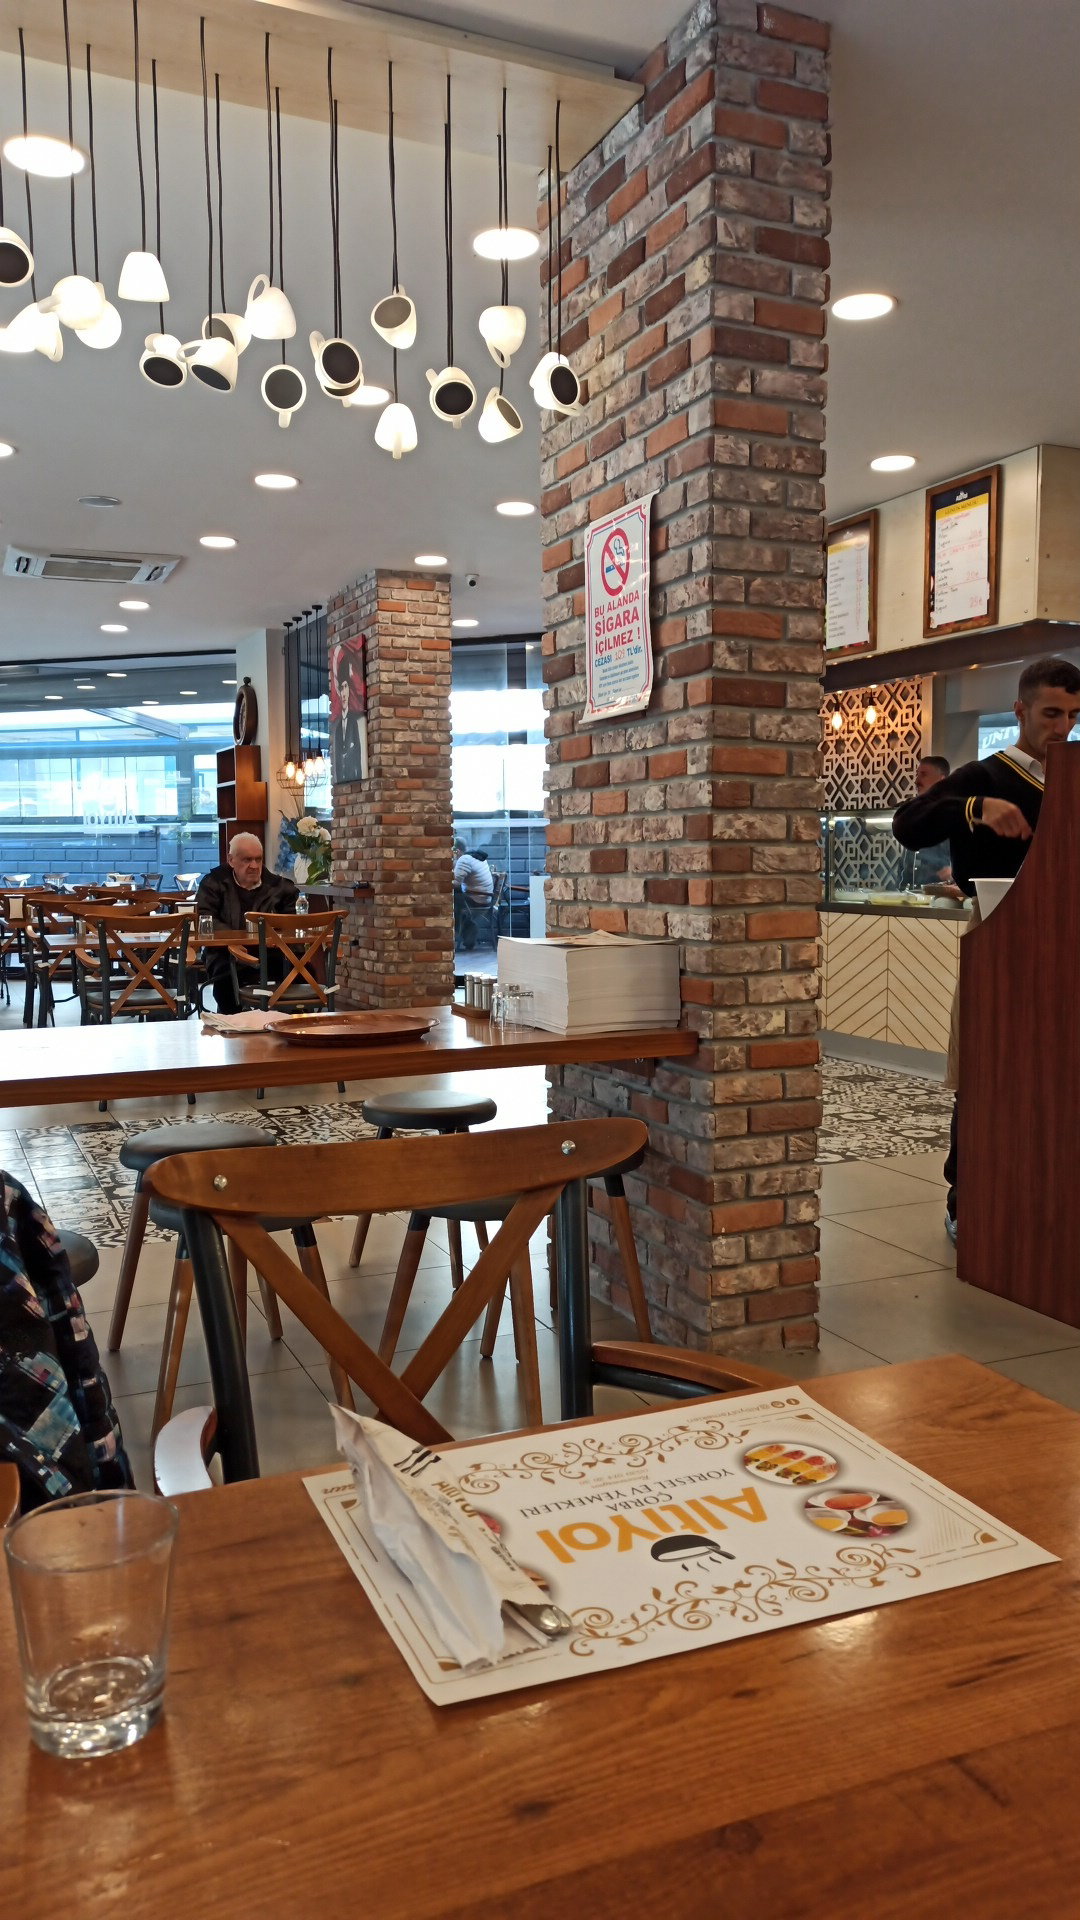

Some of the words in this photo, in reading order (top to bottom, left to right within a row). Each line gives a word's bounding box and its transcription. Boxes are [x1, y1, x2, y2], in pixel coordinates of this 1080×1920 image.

[595, 605, 604, 617] BU
[607, 590, 639, 612] ALANDA
[595, 606, 639, 637] SİGARA
[595, 630, 633, 656] İÇİLMEZ
[595, 655, 612, 667] CEZASI
[631, 1484, 653, 1495] EV
[605, 1491, 673, 1512] ÇORBA
